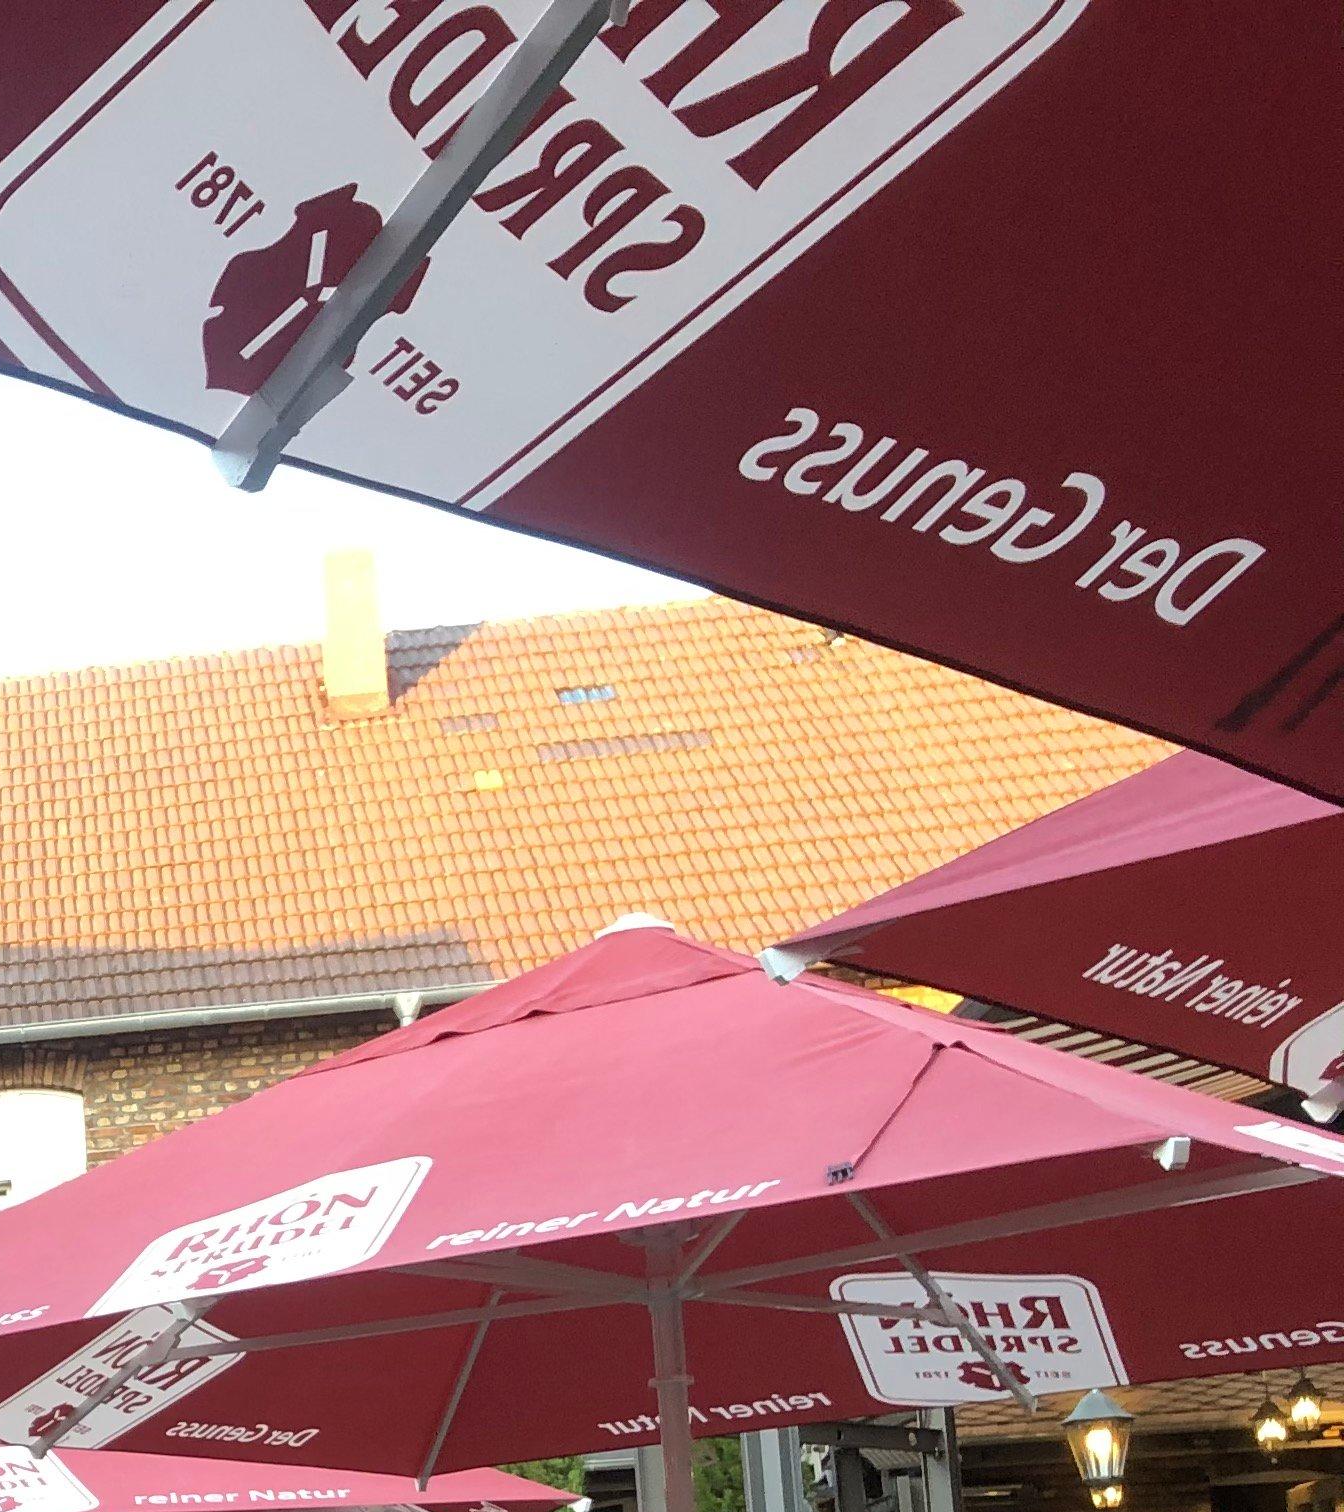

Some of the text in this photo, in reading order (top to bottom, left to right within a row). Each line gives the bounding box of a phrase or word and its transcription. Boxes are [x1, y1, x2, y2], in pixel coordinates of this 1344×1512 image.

[425, 1178, 781, 1251] reiner Natur
[134, 1488, 352, 1506] reiner Natur
